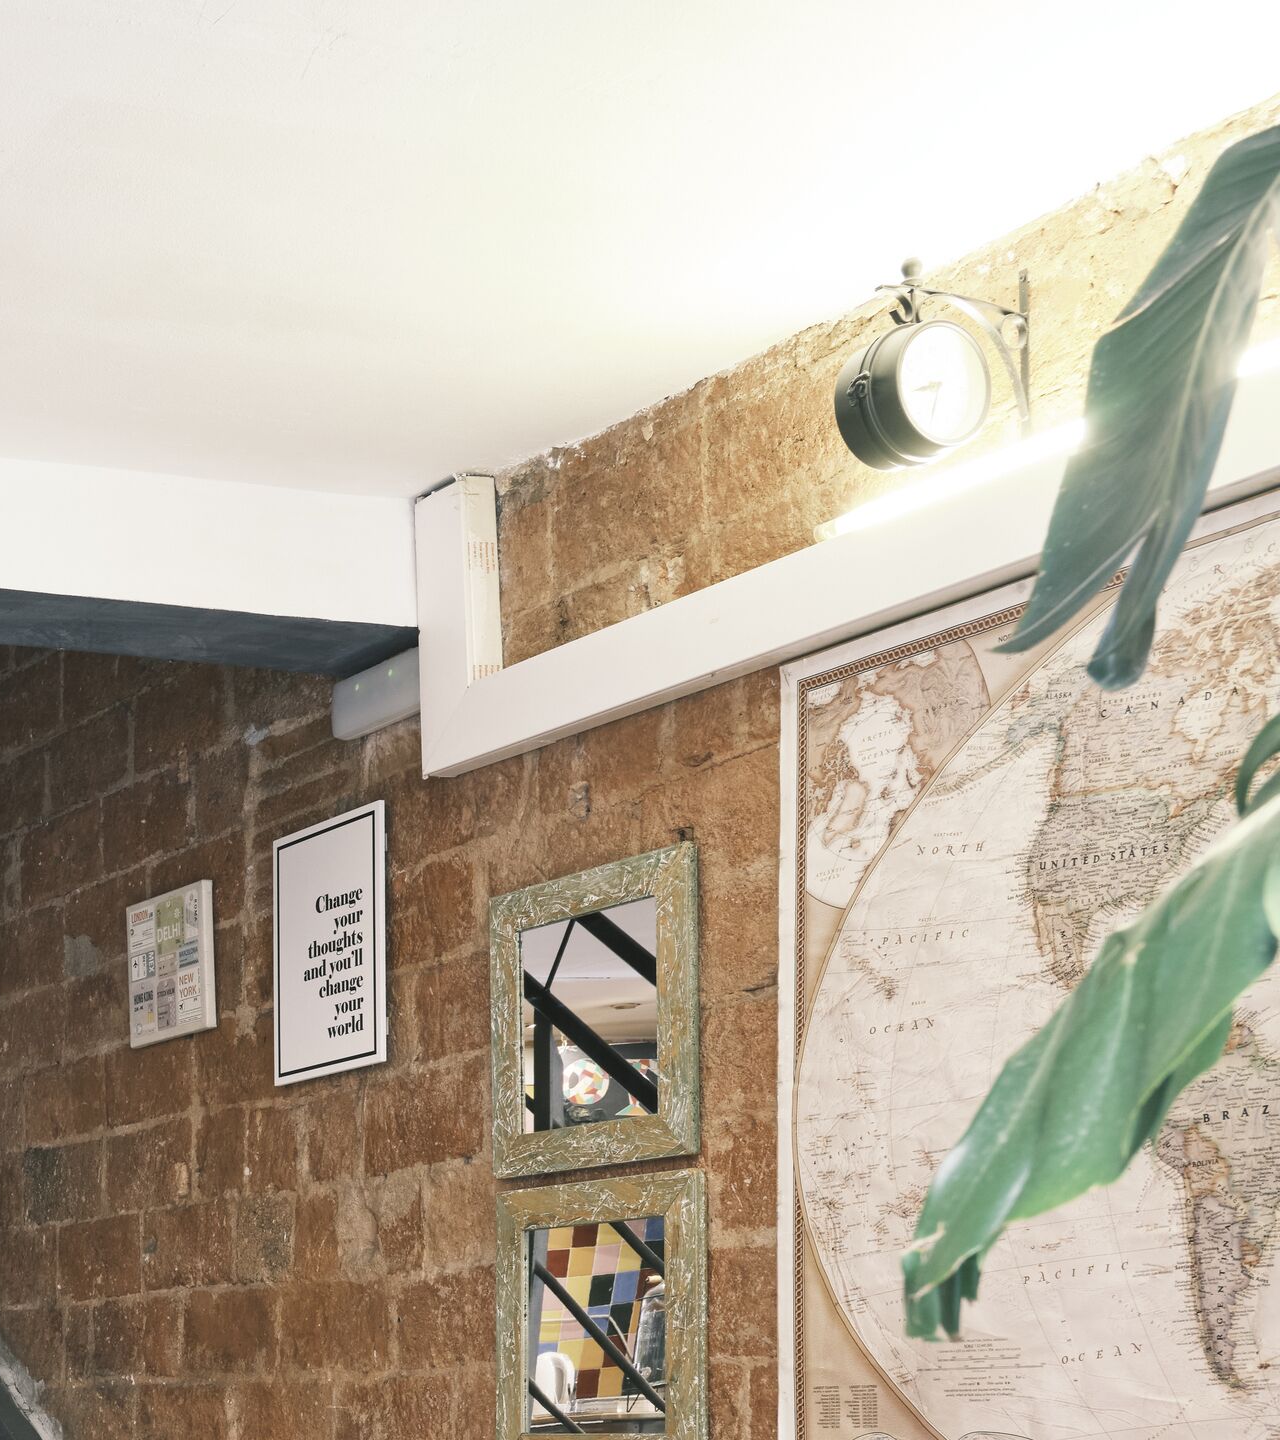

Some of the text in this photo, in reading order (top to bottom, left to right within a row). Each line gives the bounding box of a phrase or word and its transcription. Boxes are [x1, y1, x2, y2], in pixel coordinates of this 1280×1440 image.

[1045, 691, 1072, 699] ALASKA
[1100, 687, 1239, 718] CANADA
[916, 840, 985, 856] NORTH
[1039, 842, 1170, 871] UNITED STATES
[315, 888, 362, 914] Change
[131, 909, 149, 924] LONDON
[333, 909, 363, 934] your
[157, 923, 181, 942] DELHI
[308, 929, 363, 959] thoughts
[882, 929, 969, 945] PACIFIC
[304, 948, 363, 982] and you'll
[178, 973, 194, 986] NEW
[319, 975, 363, 998] change
[179, 986, 197, 999] YORK
[334, 997, 363, 1020] your
[327, 1013, 363, 1038] world
[869, 1017, 935, 1035] OCEAN
[1192, 1158, 1219, 1168] BOLIVIA
[1023, 1261, 1129, 1285] PACIFIC
[1216, 1224, 1231, 1357] ARGENTINA
[1061, 1342, 1143, 1365] OCEAN
